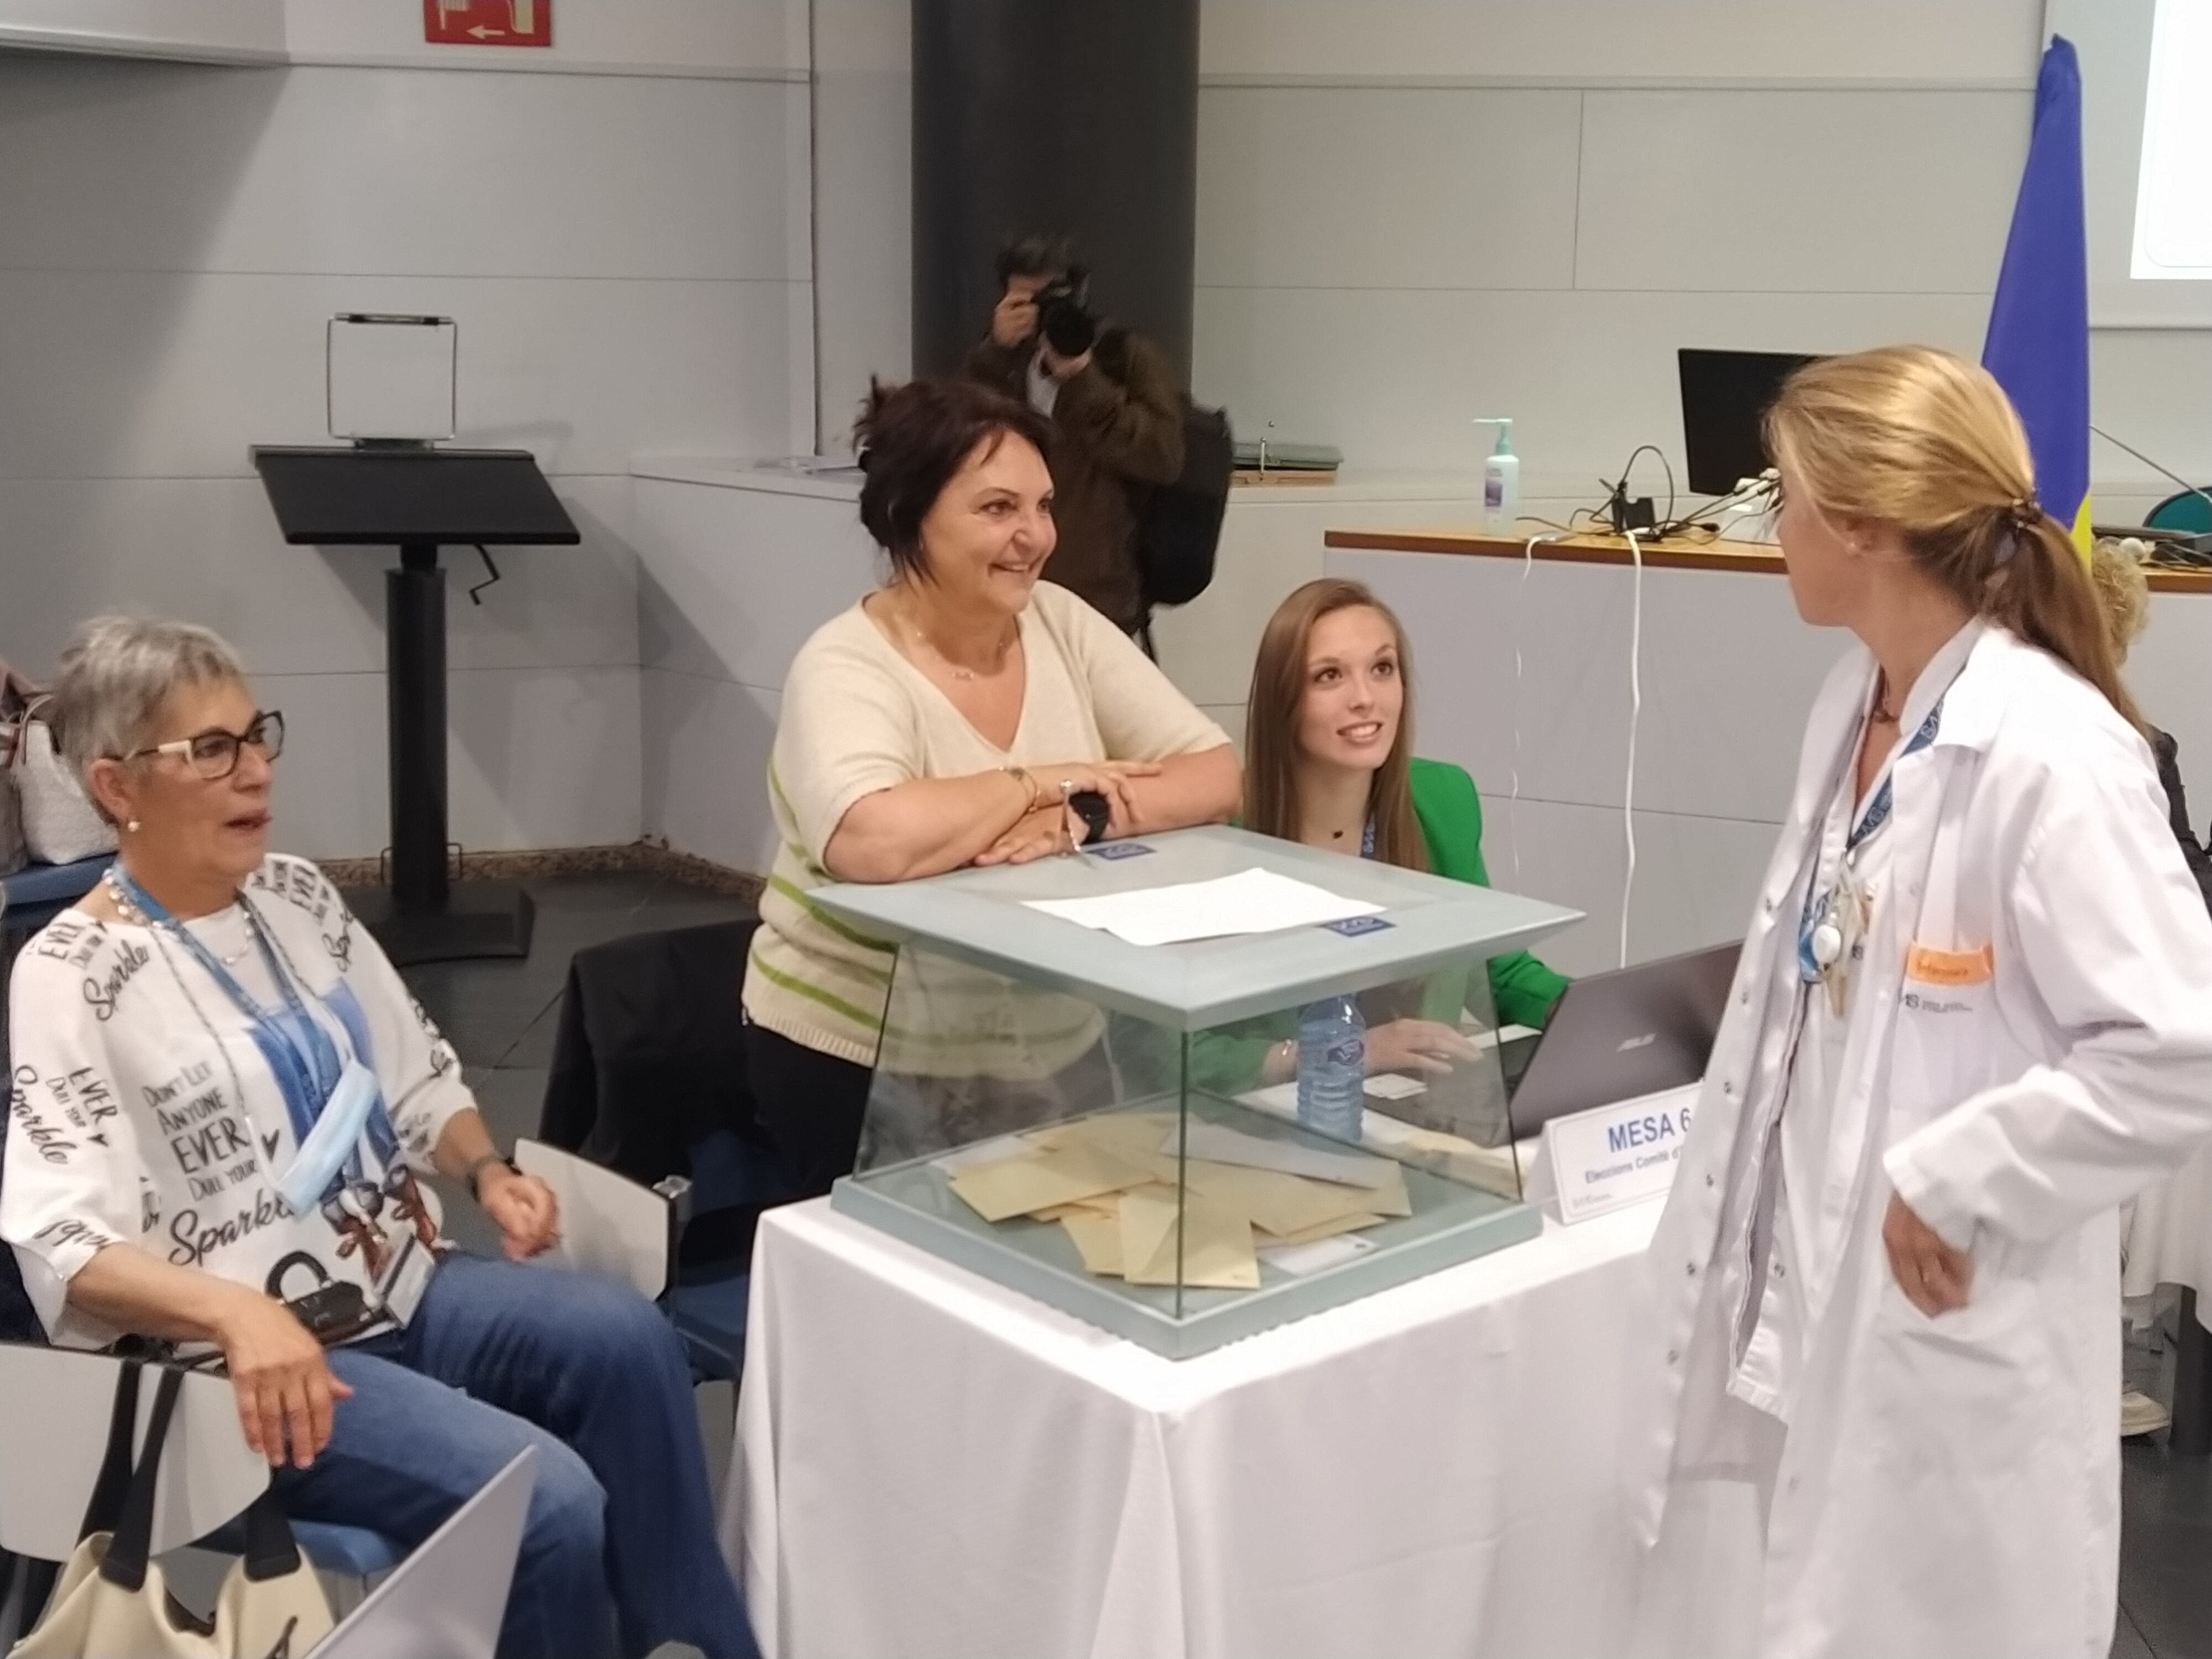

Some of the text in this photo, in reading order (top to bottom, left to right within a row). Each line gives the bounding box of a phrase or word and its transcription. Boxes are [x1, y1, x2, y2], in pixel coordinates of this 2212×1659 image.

[68, 1066, 118, 1125] EVER
[156, 1087, 228, 1136] ANYONE
[171, 1117, 250, 1174] EVER
[1608, 1108, 1691, 1153] MESA 6
[168, 1187, 295, 1267] Sparkl
